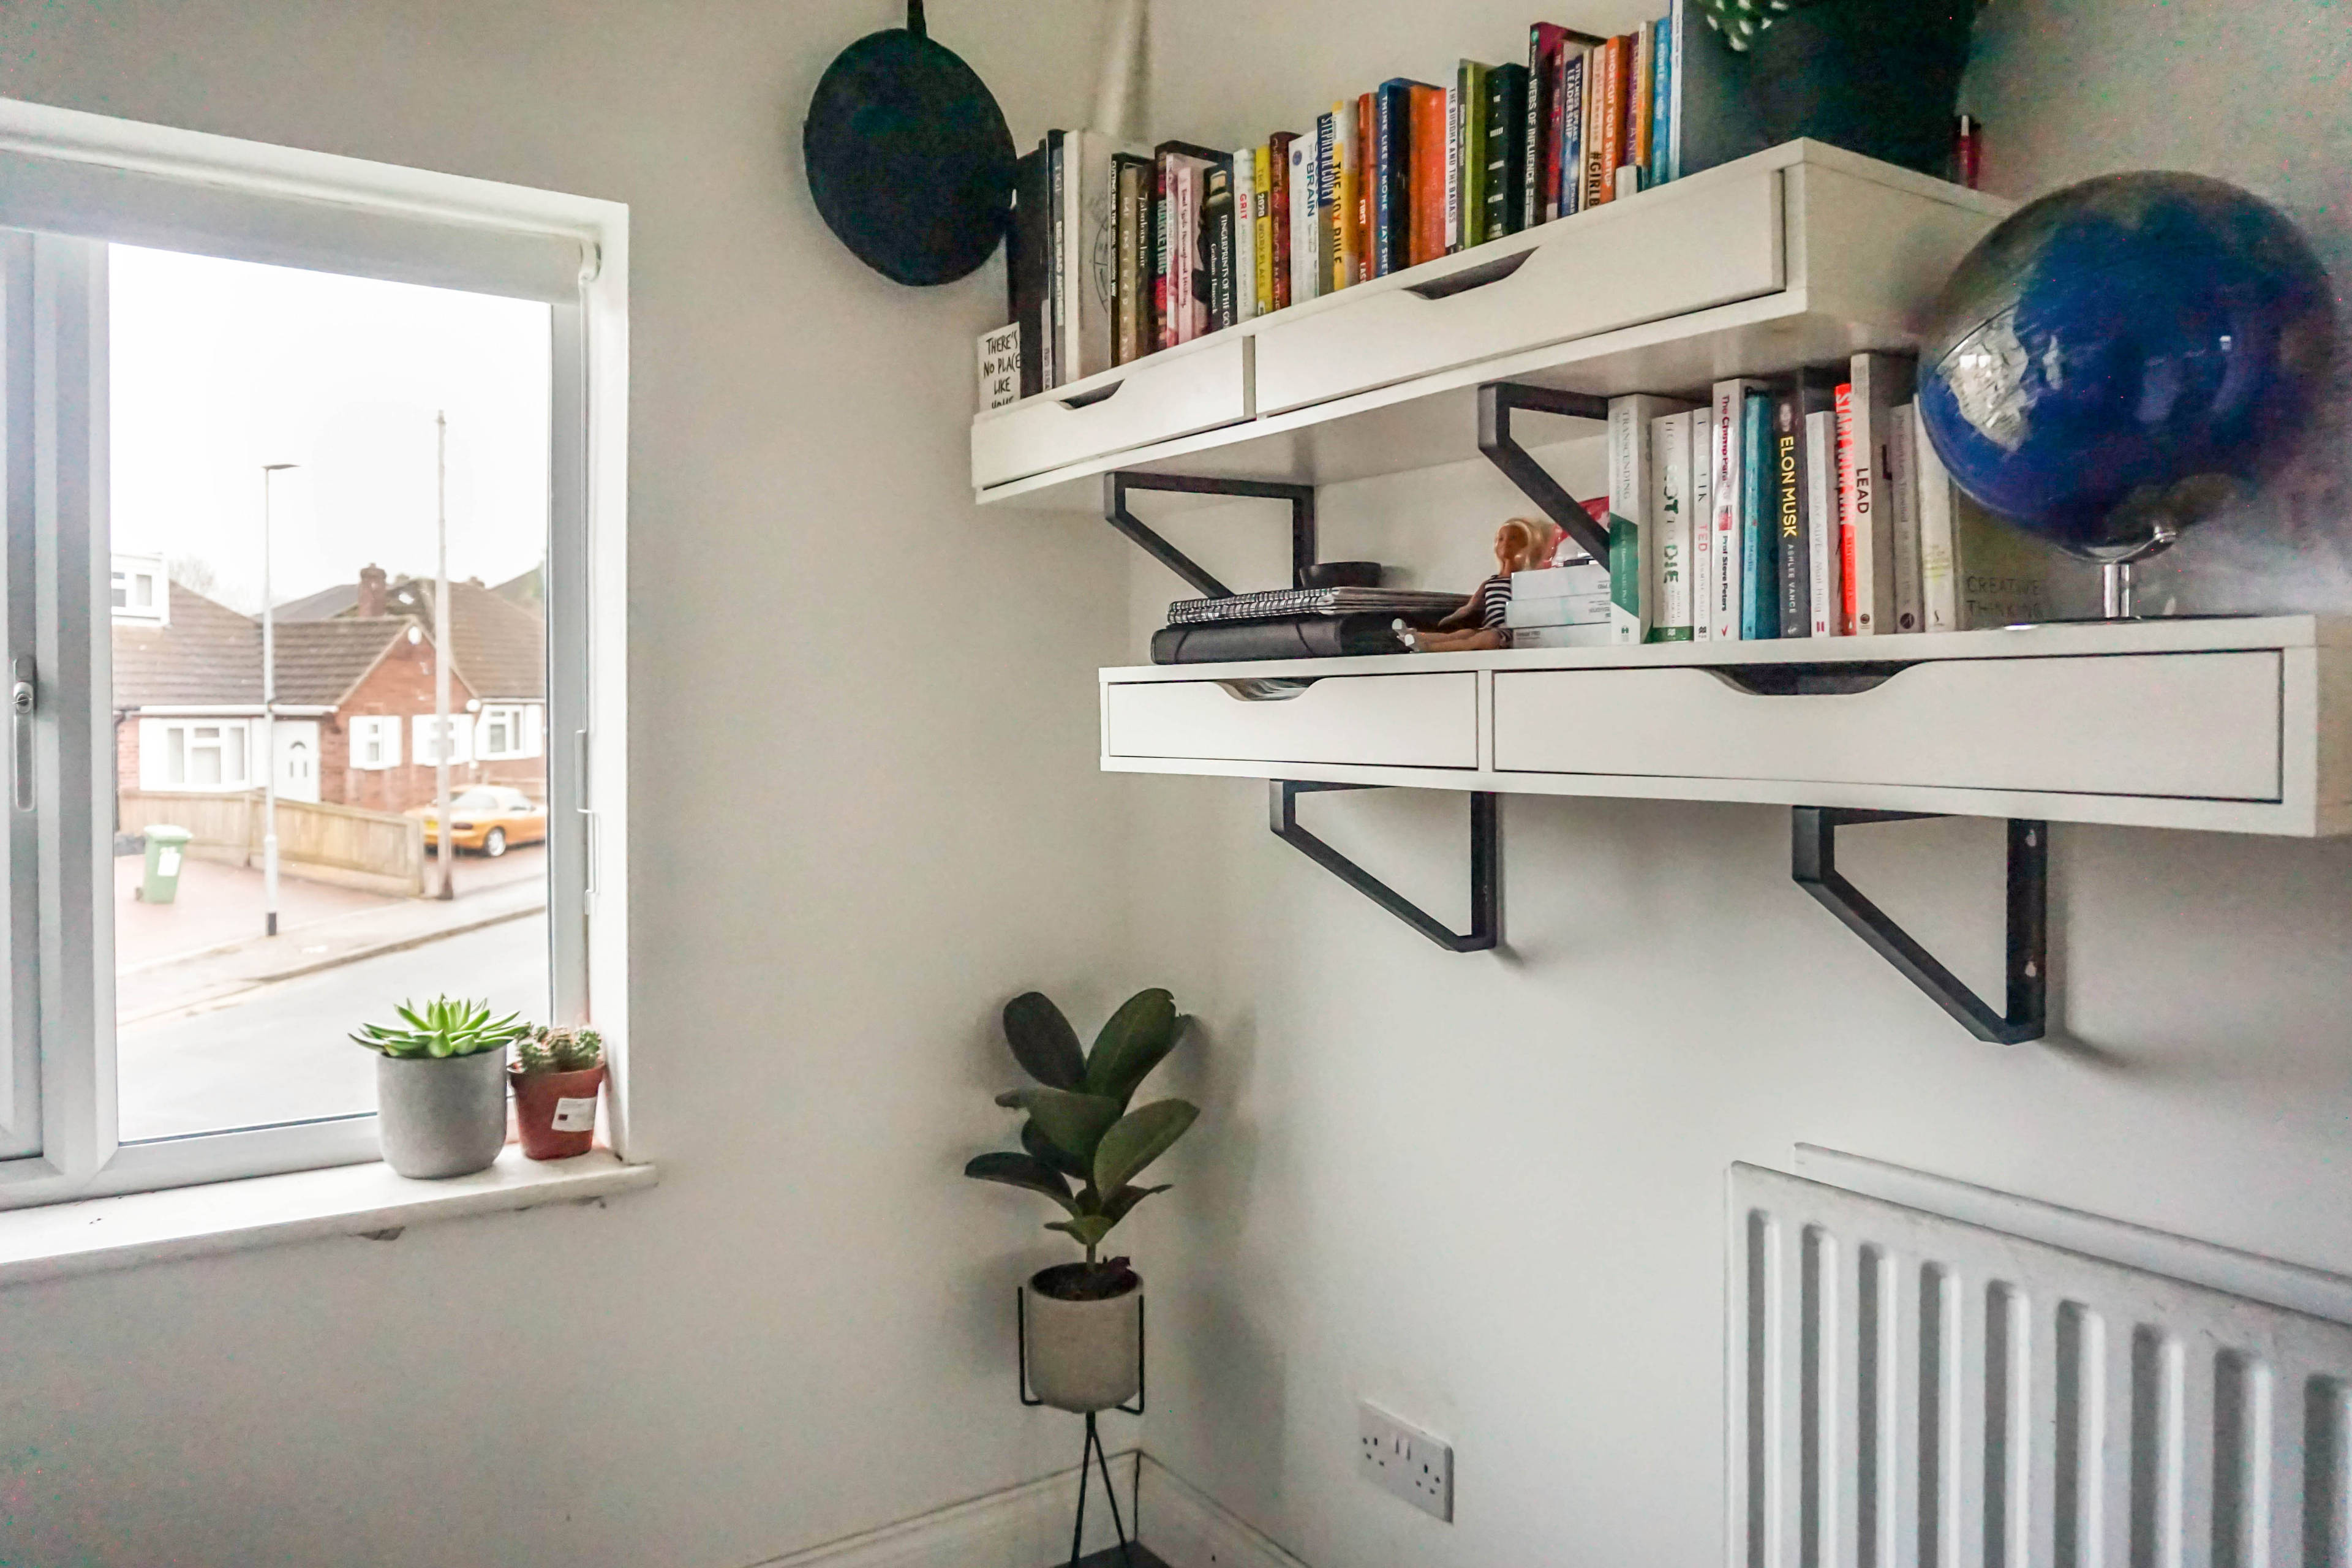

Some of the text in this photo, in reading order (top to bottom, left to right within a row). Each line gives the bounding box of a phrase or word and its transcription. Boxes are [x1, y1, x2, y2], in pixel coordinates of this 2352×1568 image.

[1528, 78, 1538, 110] WEBS
[1607, 48, 1616, 104] SHORTCUT
[1528, 111, 1537, 126] OF
[1566, 69, 1575, 138] LEADERSHIP
[1321, 116, 1333, 160] STEPHEN
[1526, 127, 1536, 184] INFLUENCE
[1322, 168, 1335, 200] COVEY
[1604, 141, 1613, 187] STARTUP
[1306, 162, 1315, 217] BRAIN
[1222, 278, 1229, 289] OF
[986, 330, 1018, 355] THERE'S
[998, 352, 1021, 375] PLACE
[993, 377, 1011, 395] LIKE
[1722, 395, 1730, 415] The
[1622, 409, 1631, 500] TRANSCENDING
[1721, 416, 1730, 456] Chimp
[1779, 435, 1795, 484] ELON
[1856, 468, 1869, 514] LEAD
[1782, 487, 1797, 538] MUSK
[1698, 524, 1708, 552] TED
[1664, 545, 1679, 583] DIE
